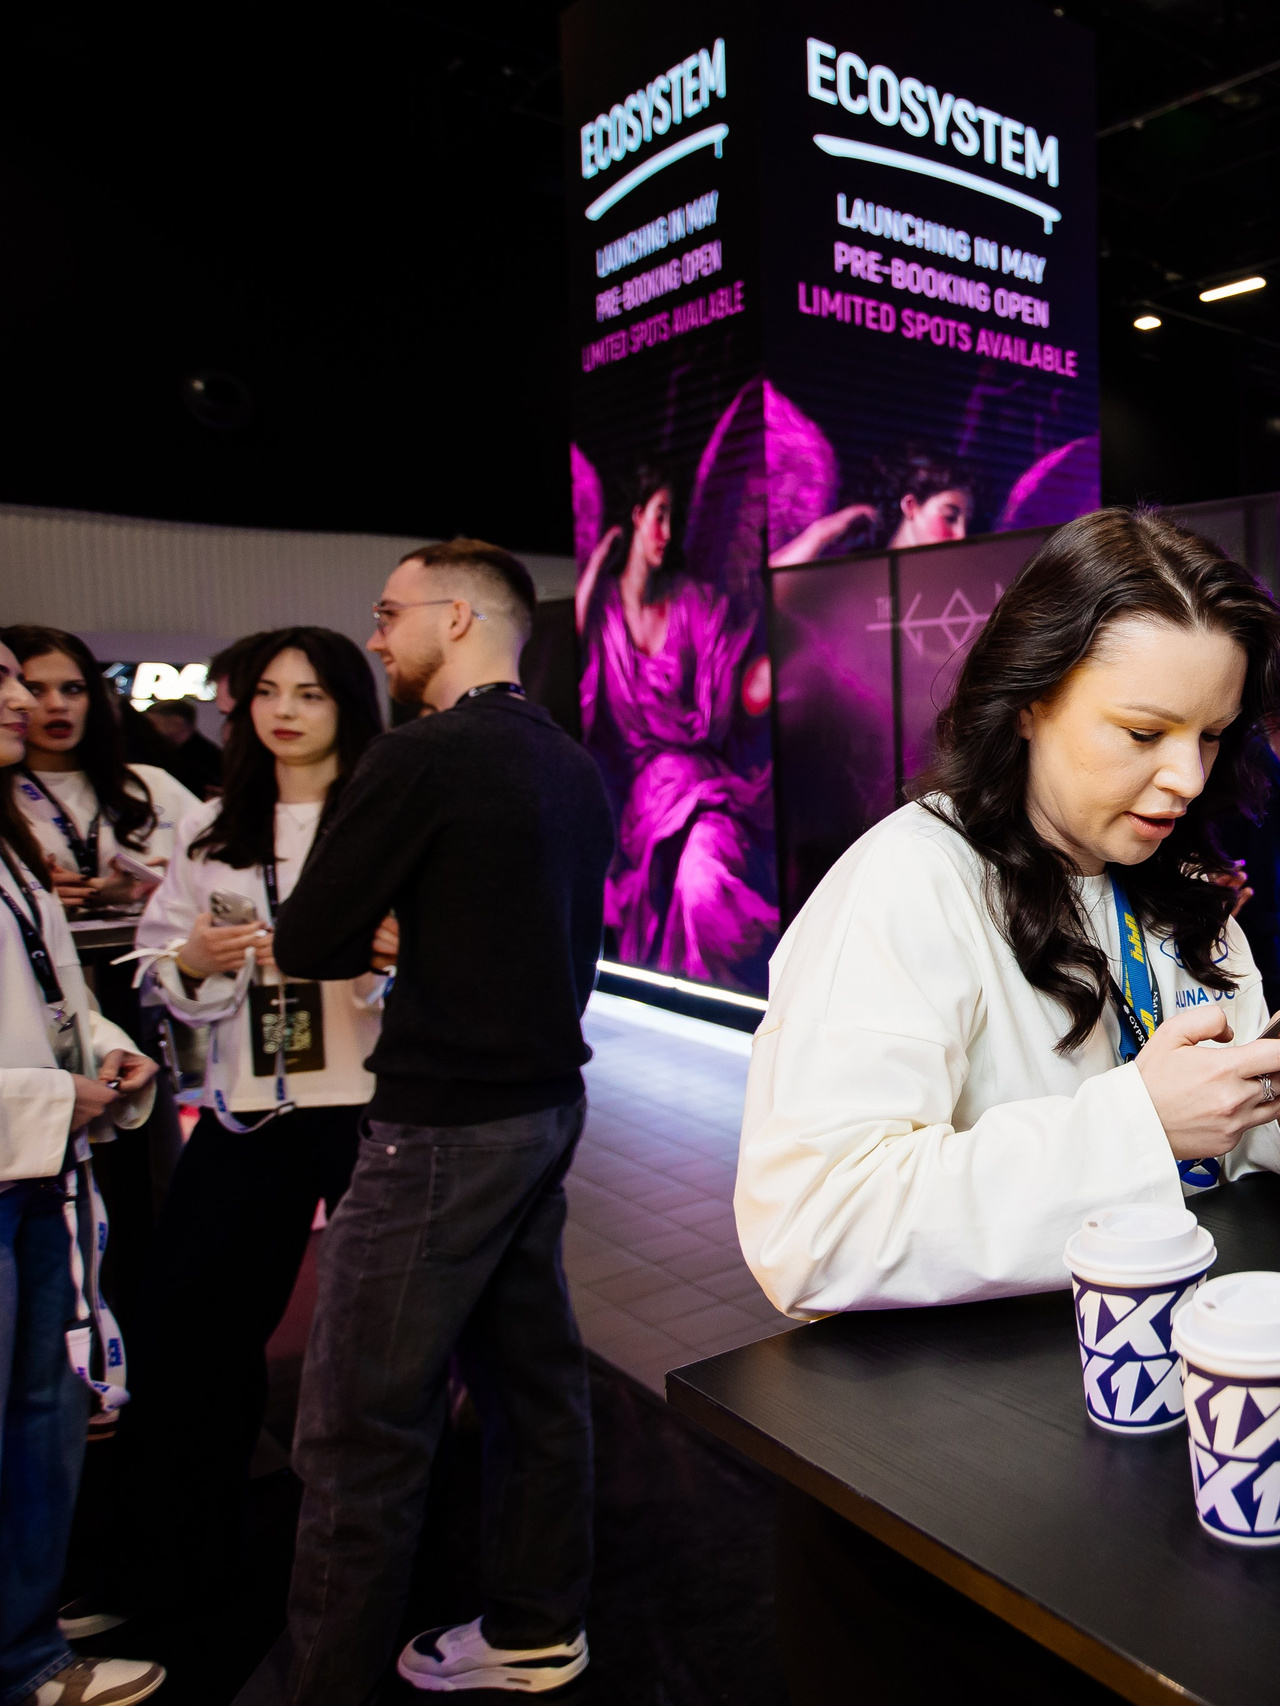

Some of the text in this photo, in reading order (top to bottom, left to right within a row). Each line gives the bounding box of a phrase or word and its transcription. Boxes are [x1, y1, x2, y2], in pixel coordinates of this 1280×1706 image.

[580, 36, 727, 179] ECOSYSTEM
[807, 36, 1060, 188] ECOSYSTEM
[596, 189, 719, 278] LAUNCHING IN MAY
[837, 192, 1047, 284] LAUNCHING IN MAY
[581, 280, 746, 373] LIMITED SPOTS AVAILABLE
[596, 239, 722, 323] PRE-BOOKING OPEN
[834, 241, 1050, 328] PRE-BOOKING OPEN
[799, 281, 1079, 378] LIMITED SPOTS AVAILABLE
[1128, 1015, 1146, 1047] GYPSY
